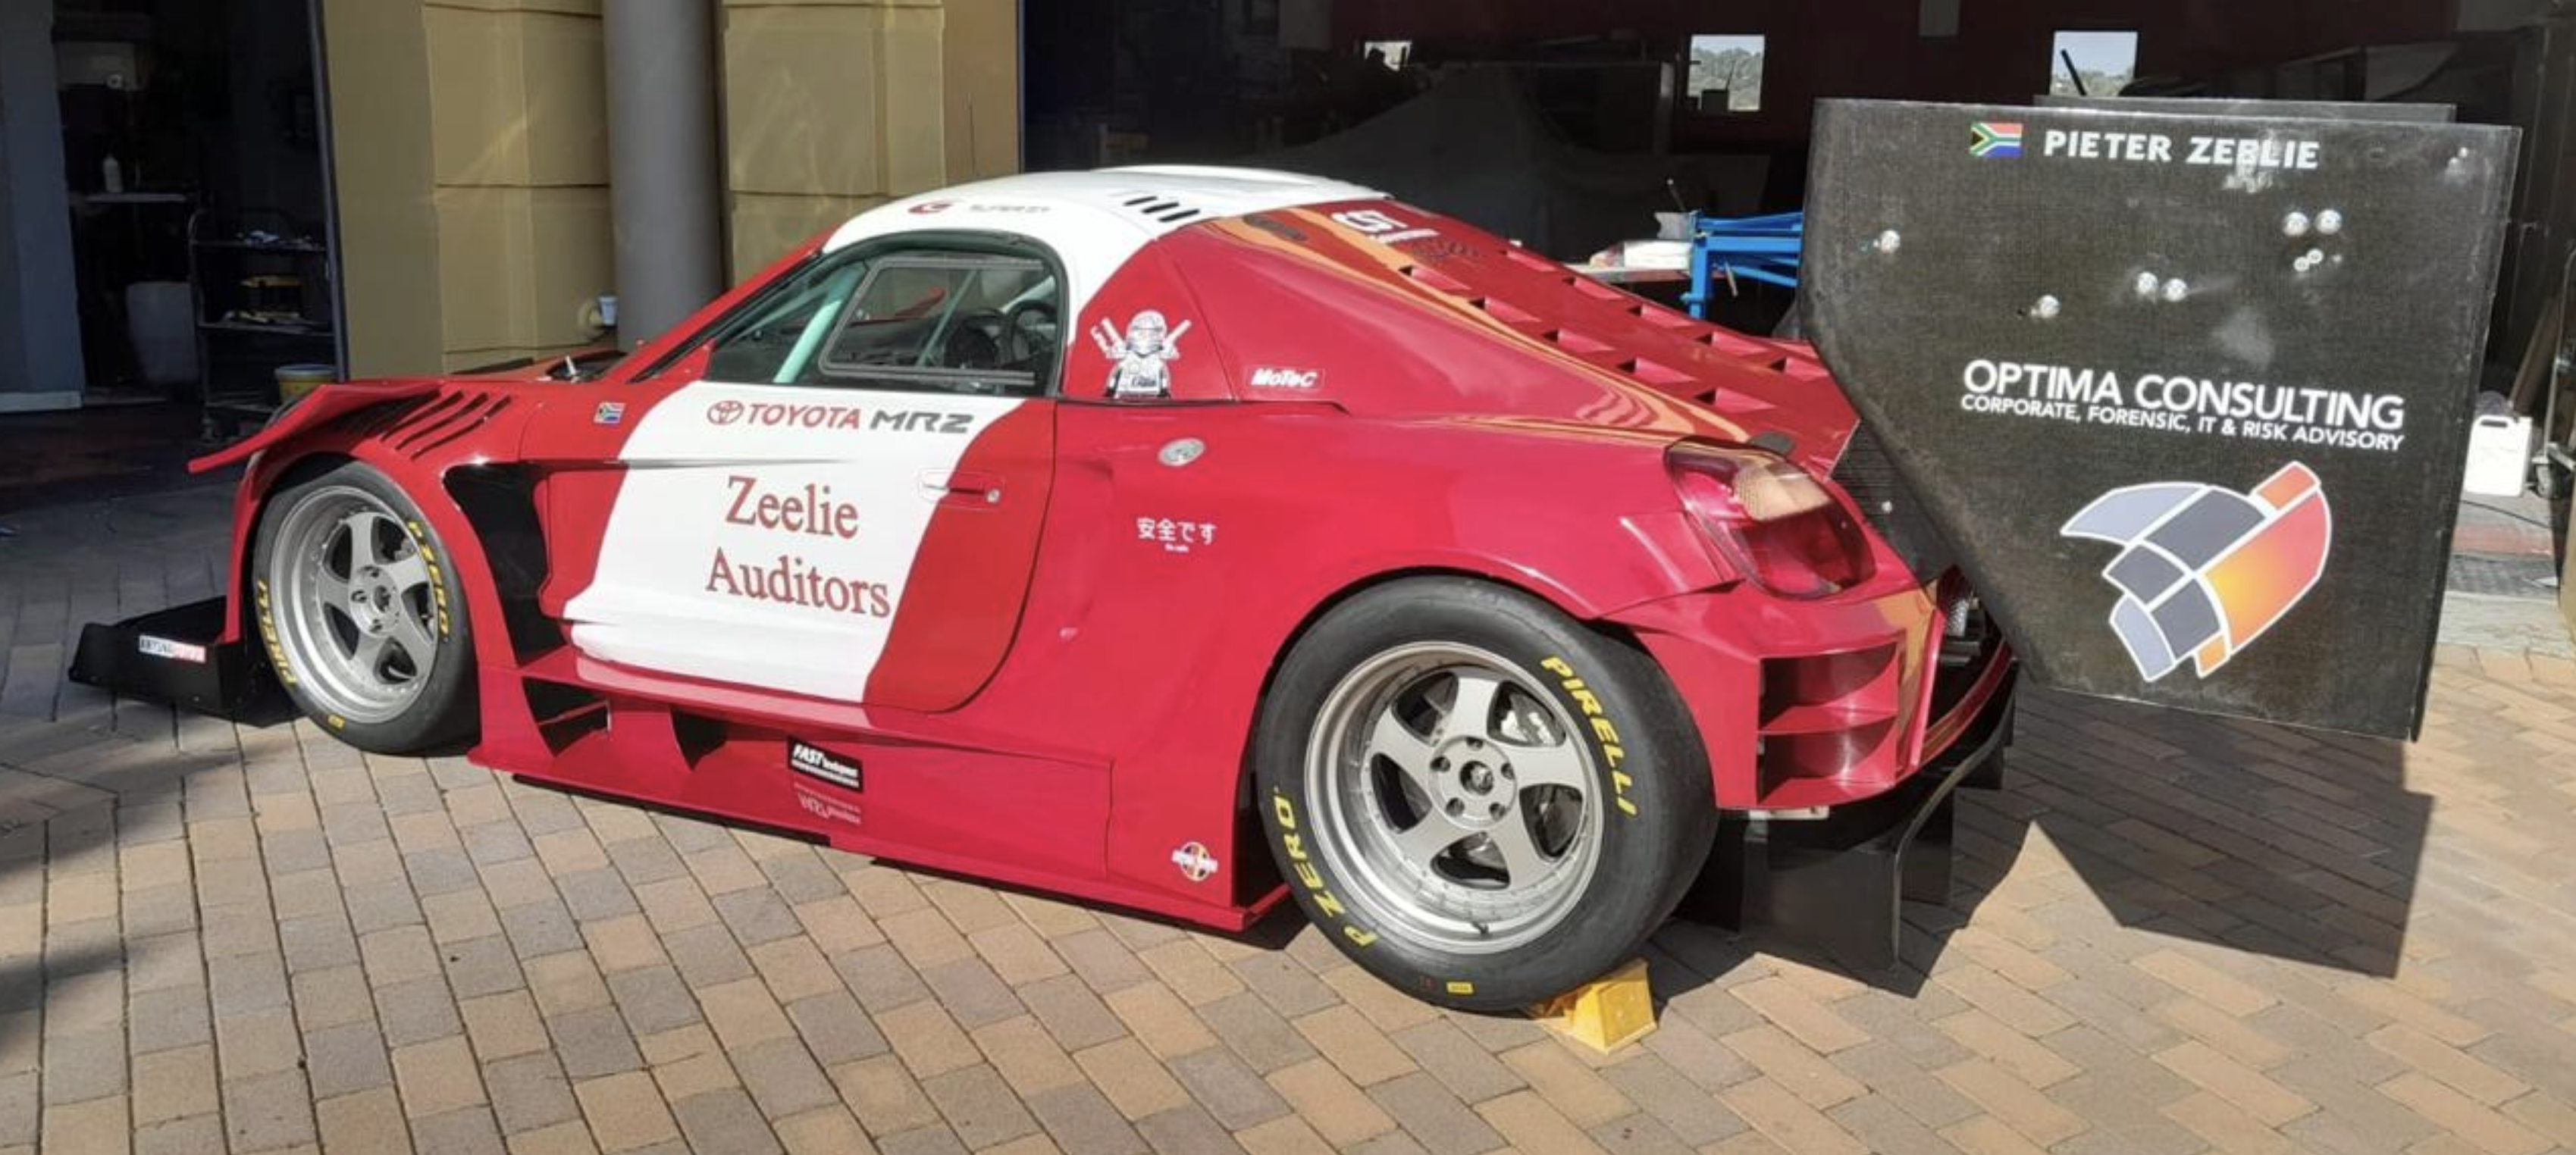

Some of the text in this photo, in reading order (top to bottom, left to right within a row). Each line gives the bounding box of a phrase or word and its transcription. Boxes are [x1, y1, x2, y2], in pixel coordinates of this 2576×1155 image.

[2043, 130, 2171, 162] PIETER
[747, 402, 862, 430] TOYOTA
[1961, 393, 2405, 451] CORPORATE, FORENSIC, IT & RISK ADVISORY
[1963, 358, 2405, 430] OPTIMA CONSULTING
[725, 474, 859, 539] Zeelie
[1136, 517, 1218, 545] 安全です
[705, 546, 891, 618] Auditors
[1540, 656, 1637, 816] PIRELLI
[1273, 795, 1378, 947] P ZERO
